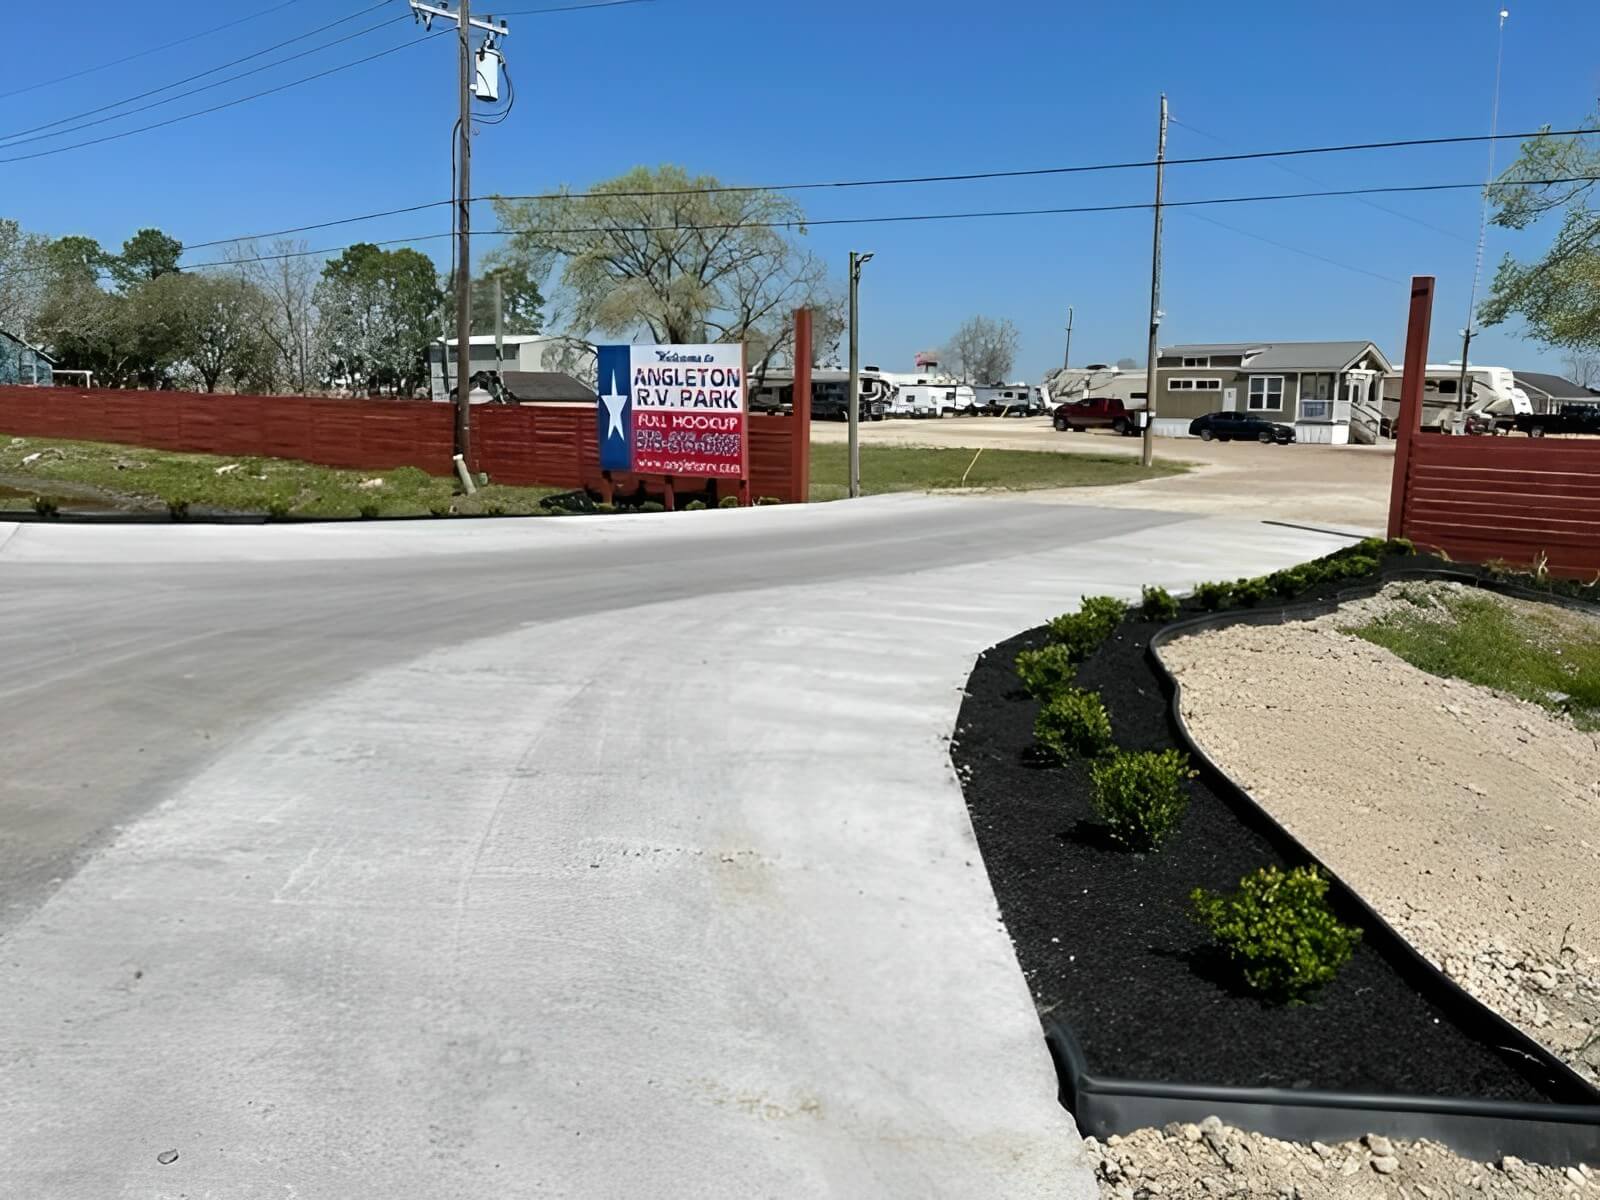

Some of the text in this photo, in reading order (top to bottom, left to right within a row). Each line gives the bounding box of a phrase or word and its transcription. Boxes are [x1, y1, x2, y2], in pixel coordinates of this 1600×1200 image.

[634, 367, 740, 388] ANGLETON
[637, 388, 738, 409] R.V. PARK
